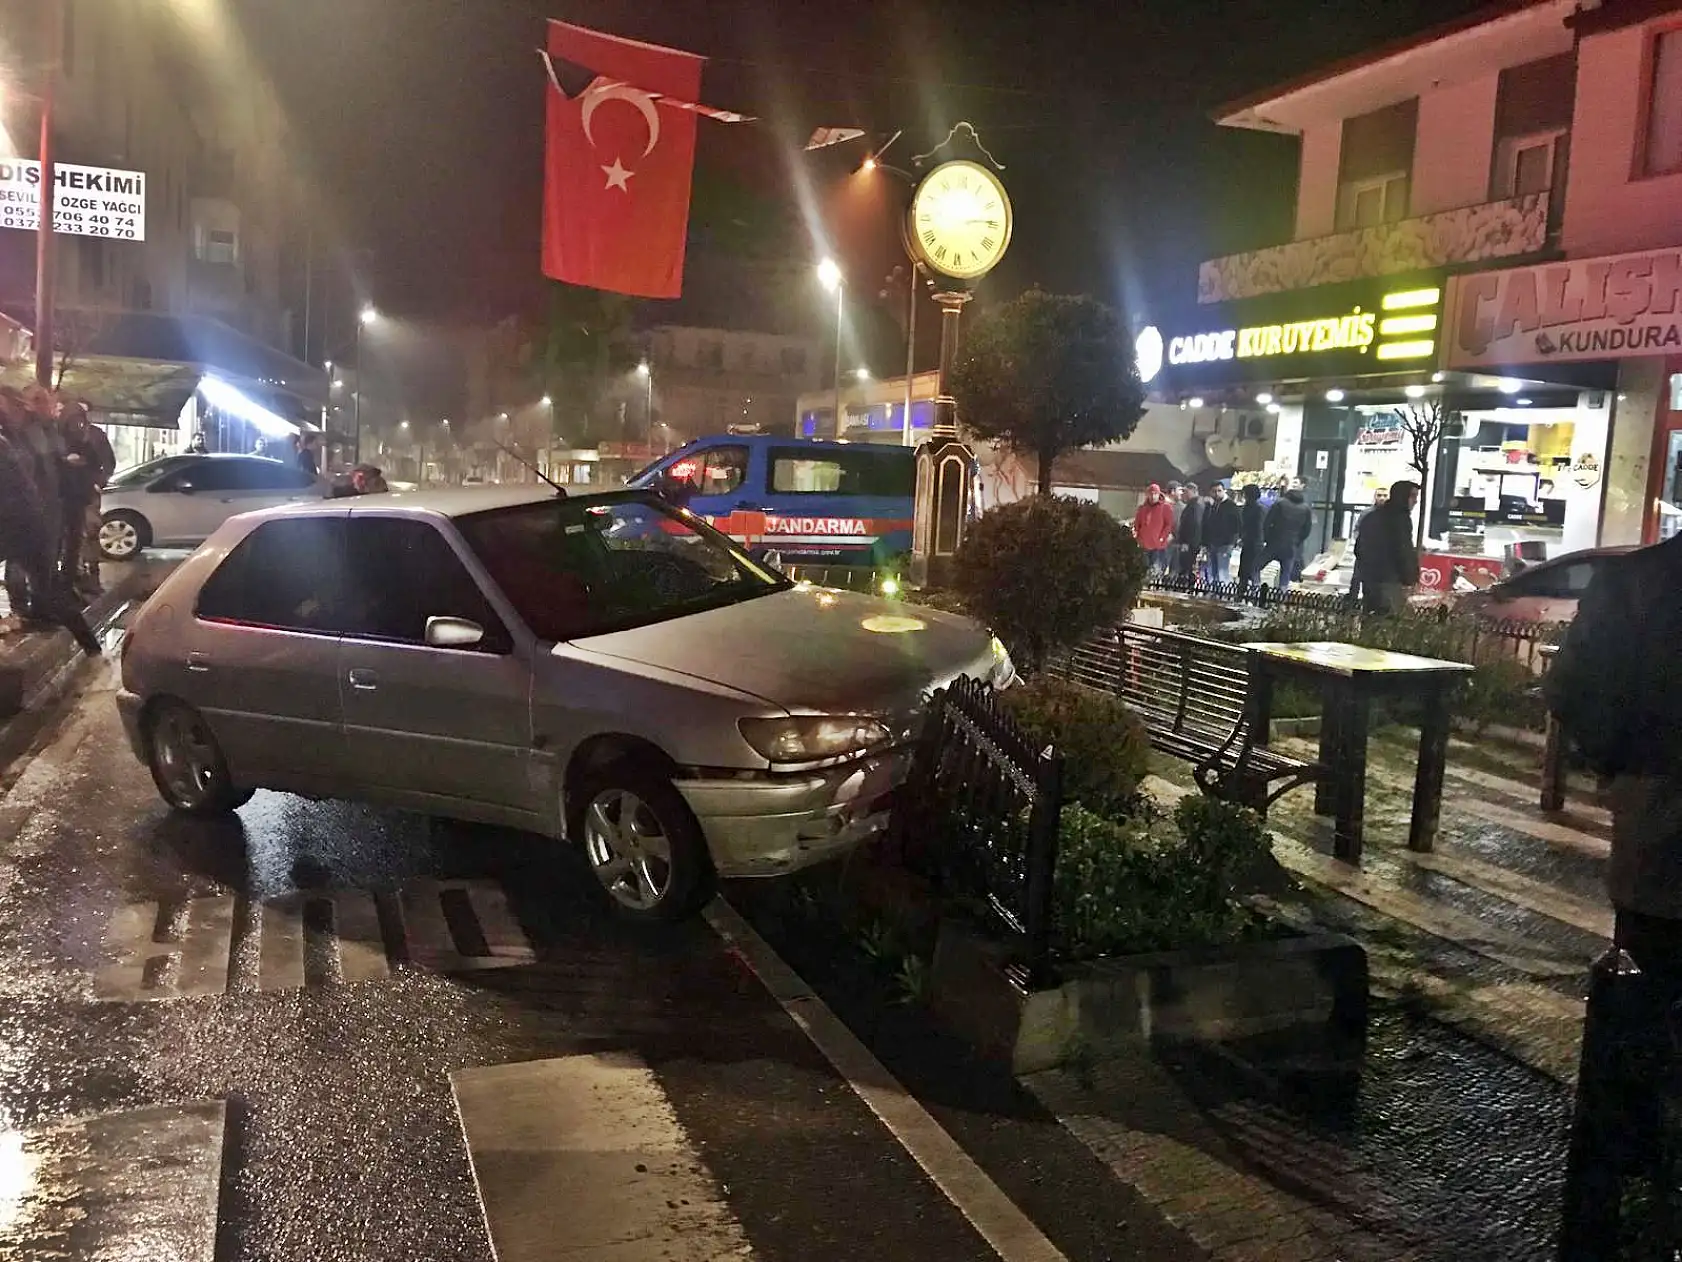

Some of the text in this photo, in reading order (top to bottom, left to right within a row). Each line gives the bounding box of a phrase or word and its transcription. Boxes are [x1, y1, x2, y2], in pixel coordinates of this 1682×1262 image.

[0, 163, 141, 195] DİŞ HEKİMİ
[4, 206, 135, 227] 055 706 40 74
[53, 222, 83, 233] 233
[89, 226, 109, 235] 20
[114, 228, 135, 238] 70
[1169, 305, 1376, 365] CADDE KURUYEMİŞ
[1560, 325, 1681, 353] KUNDURA
[766, 517, 866, 534] JANDARMA
